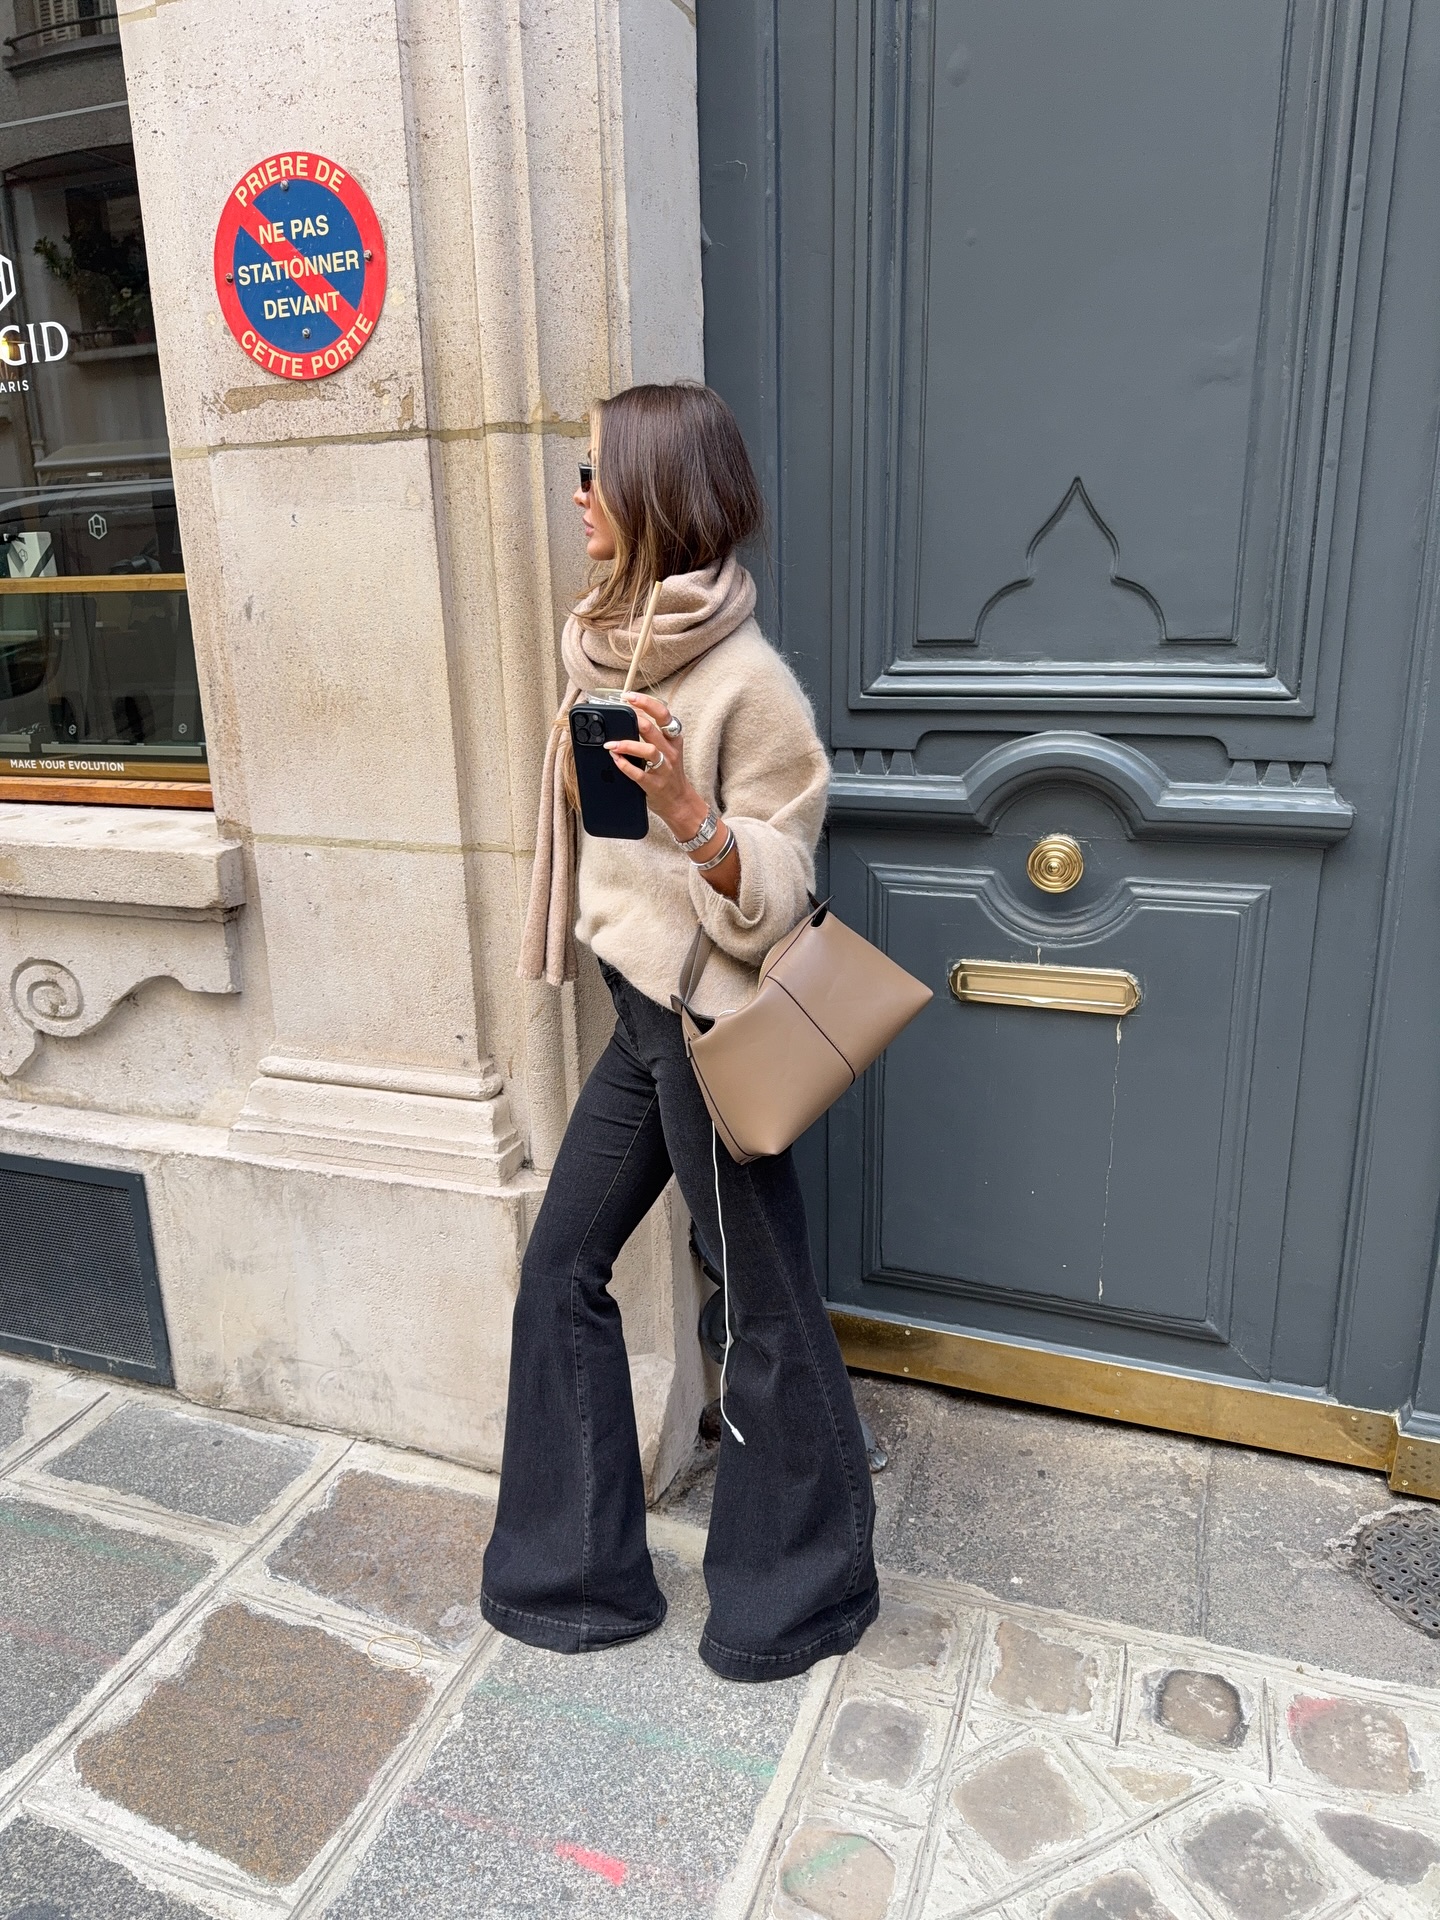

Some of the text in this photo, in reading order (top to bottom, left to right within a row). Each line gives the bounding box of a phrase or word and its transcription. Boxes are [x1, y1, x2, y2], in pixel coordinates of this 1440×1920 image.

[235, 155, 346, 208] PRIERE DE
[258, 214, 330, 245] NE PAS
[237, 249, 360, 286] STATIONNER
[263, 291, 341, 320] DEVANT
[241, 313, 374, 377] CETTE PORTE
[10, 759, 125, 772] MAKE YOUR EVOLUTION
